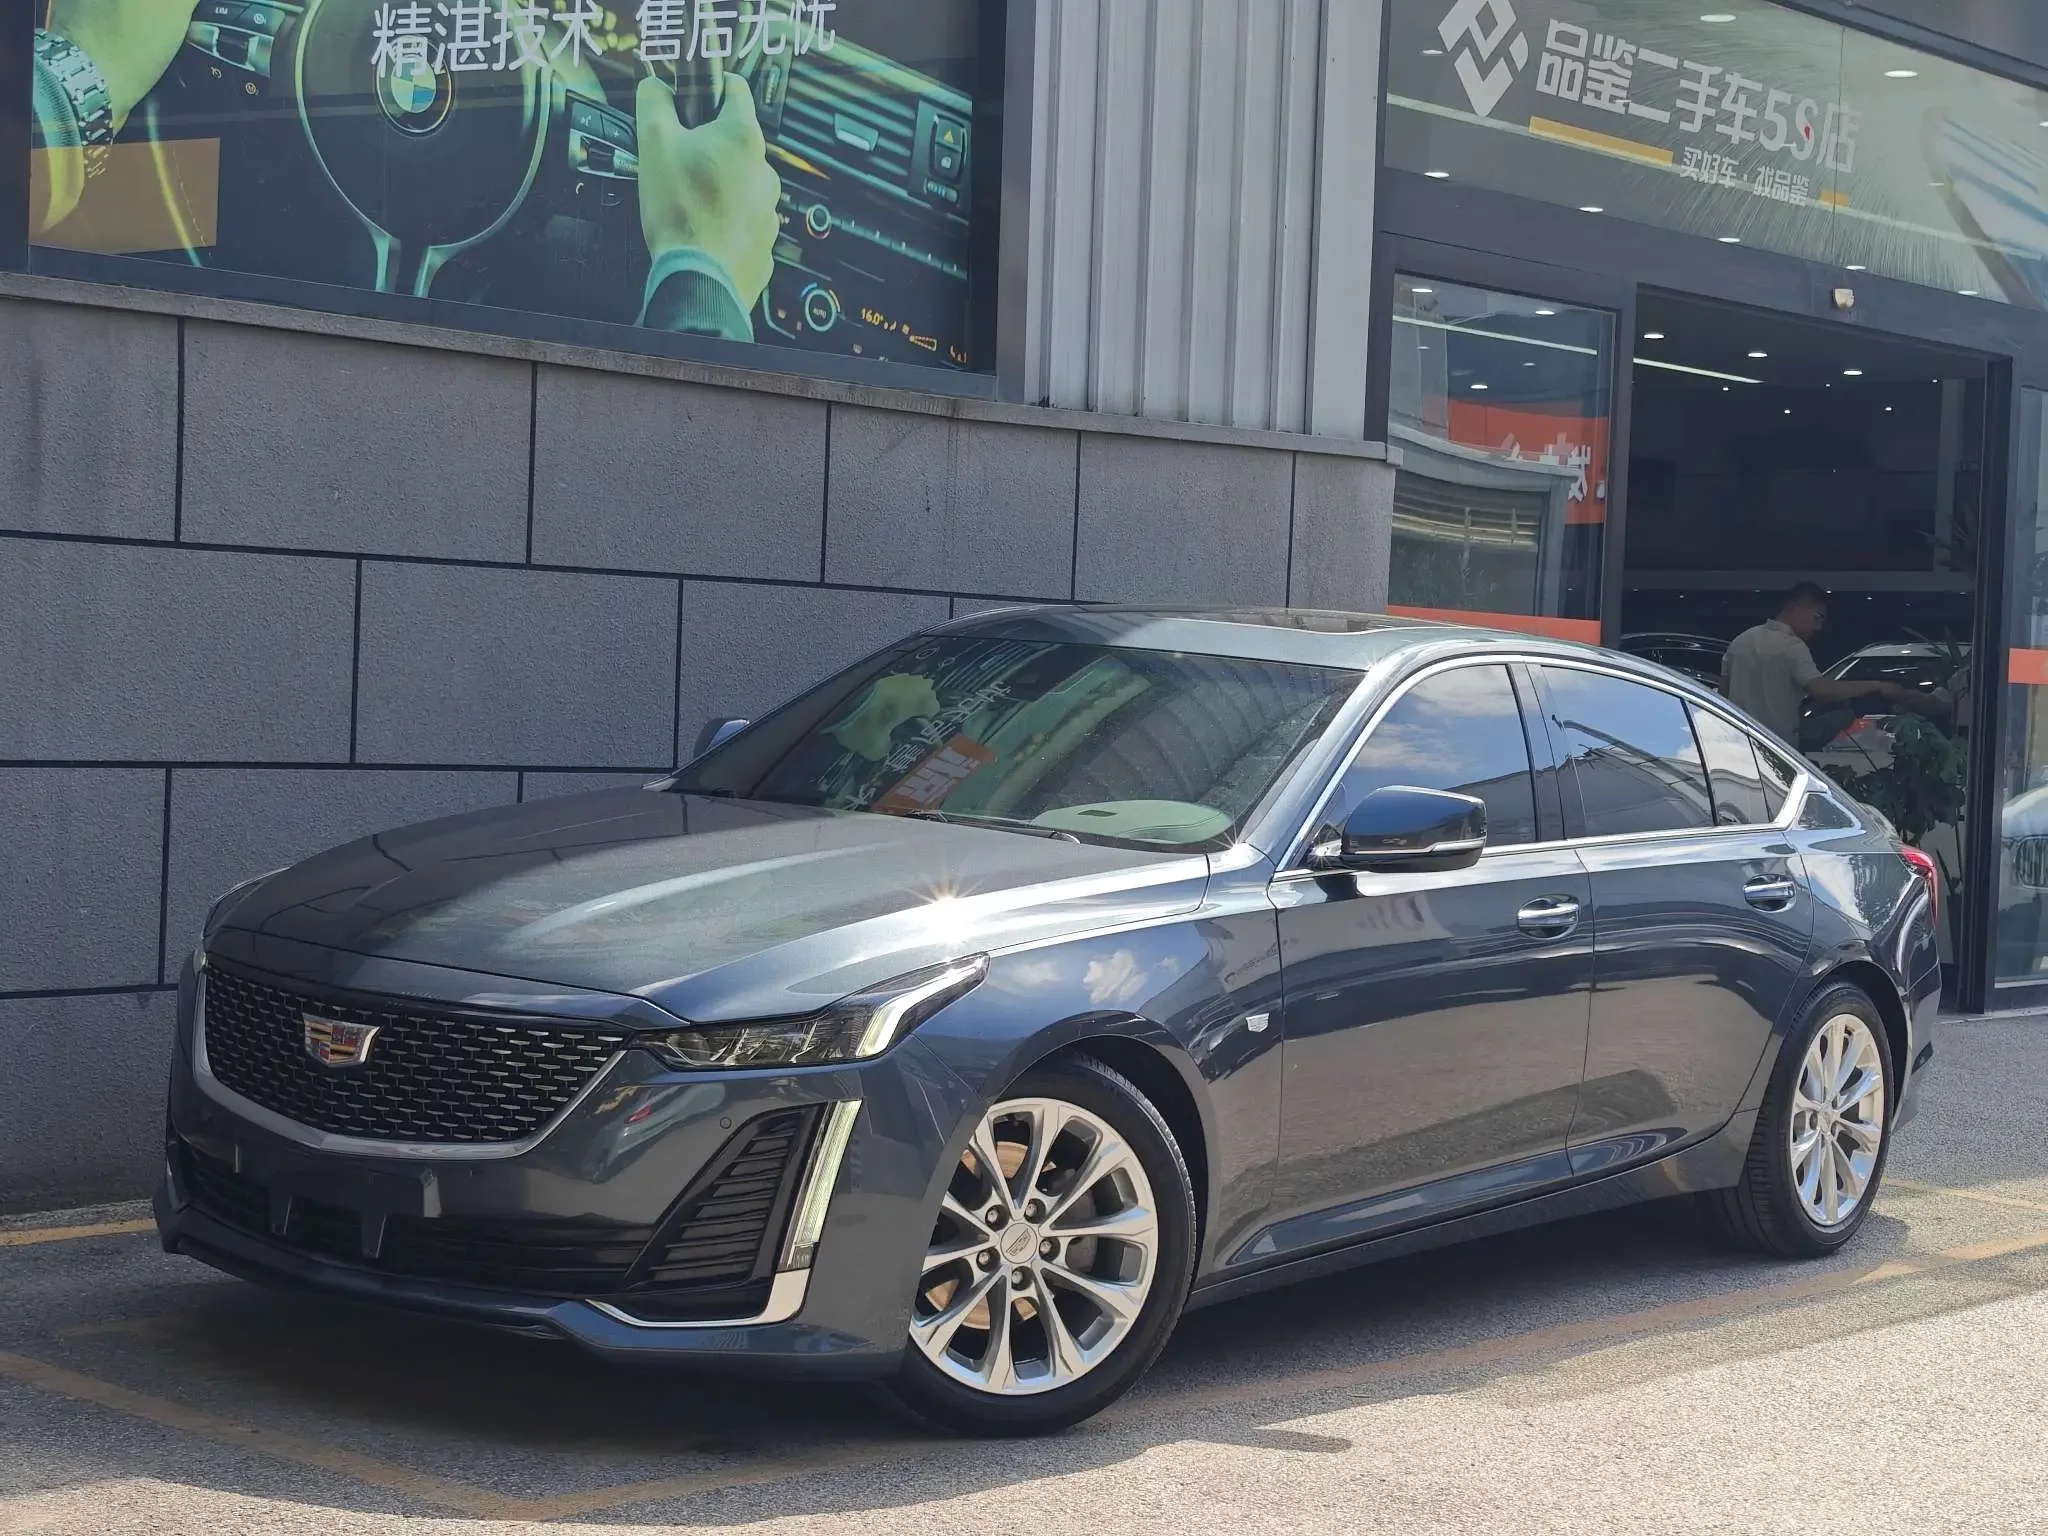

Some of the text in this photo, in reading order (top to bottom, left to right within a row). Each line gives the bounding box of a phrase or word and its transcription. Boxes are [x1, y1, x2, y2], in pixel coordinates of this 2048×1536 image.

[372, 0, 837, 79] 精湛技术 售后无忧
[1536, 19, 1861, 173] 品鉴二手车5S店
